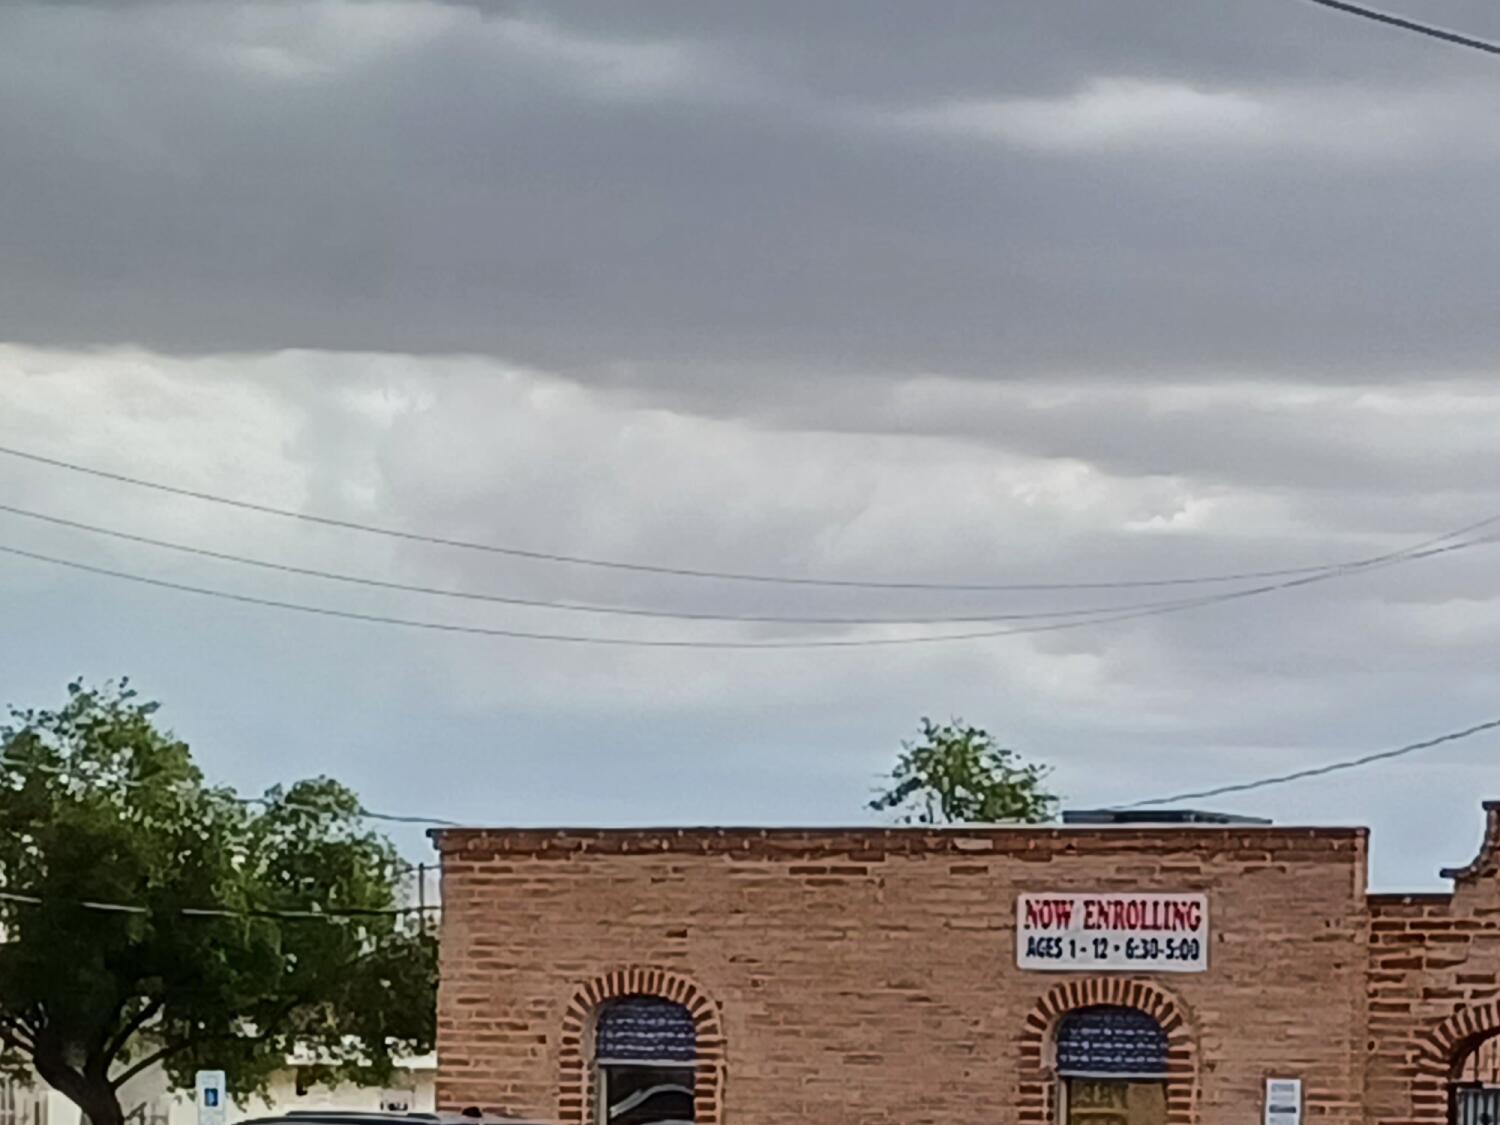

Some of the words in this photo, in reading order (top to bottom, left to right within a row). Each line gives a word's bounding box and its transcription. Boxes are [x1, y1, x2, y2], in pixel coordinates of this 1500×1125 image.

[1024, 899, 1074, 930] NOW
[1083, 900, 1201, 931] ENROLLING
[1026, 936, 1062, 959] AGES
[1069, 939, 1076, 959] 1
[1092, 938, 1108, 959] 12
